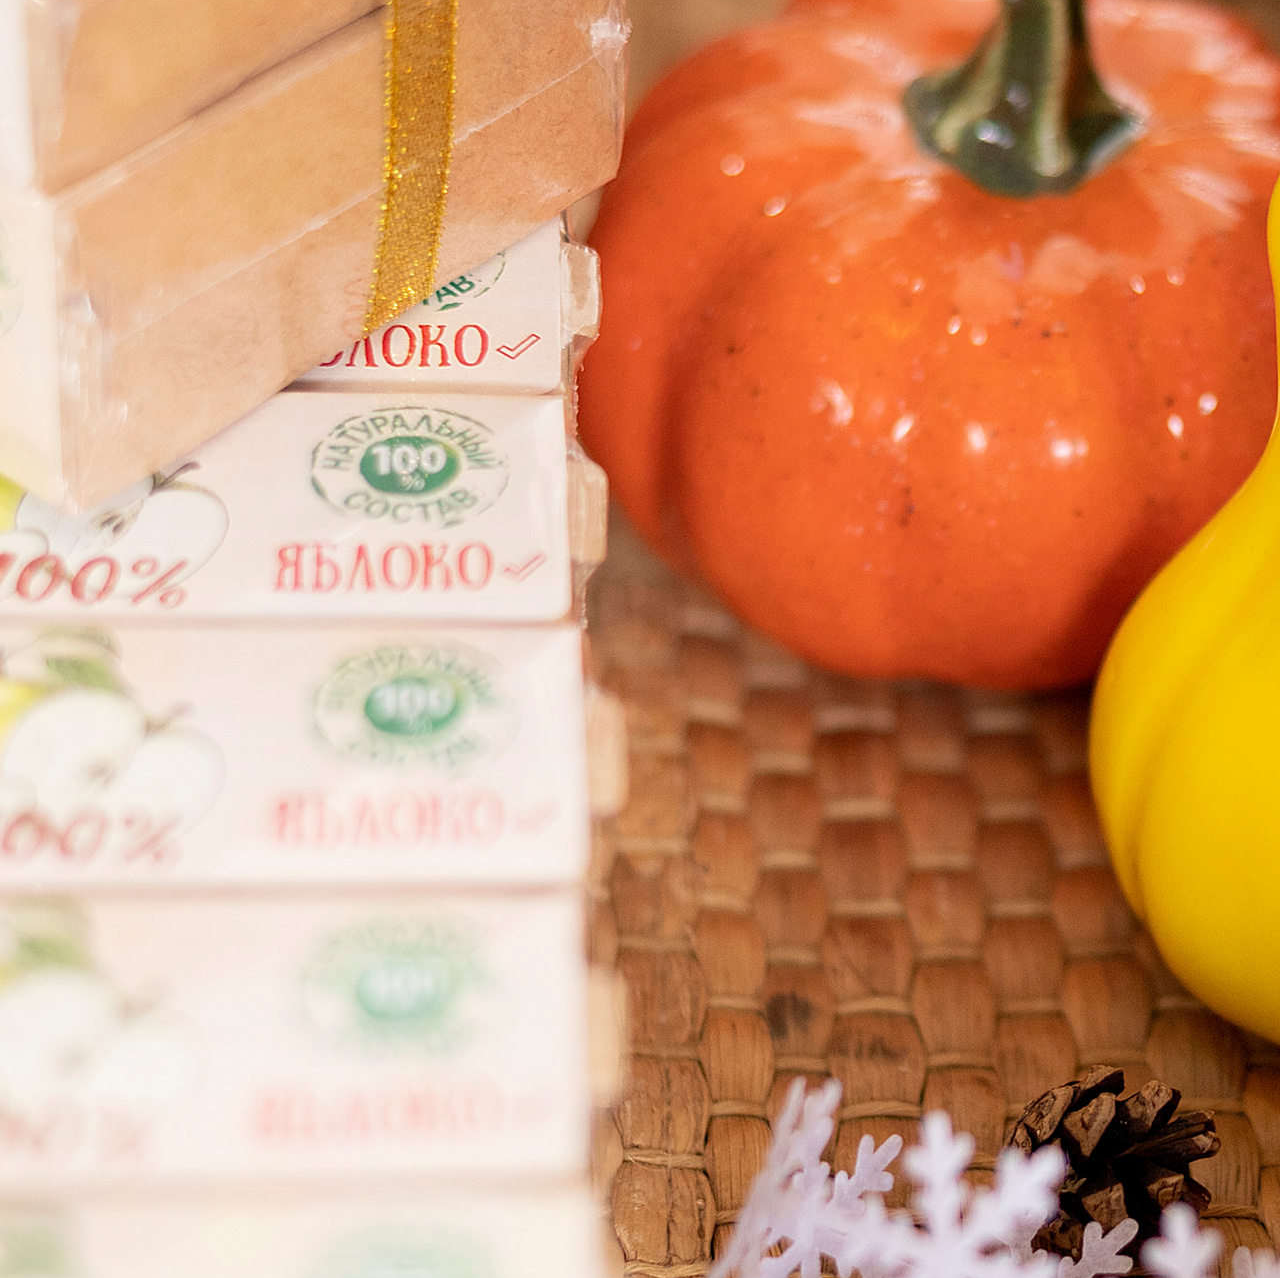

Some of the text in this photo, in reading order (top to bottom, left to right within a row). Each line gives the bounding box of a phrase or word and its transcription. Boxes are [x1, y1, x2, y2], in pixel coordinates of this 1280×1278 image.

[371, 443, 448, 476] 100
[343, 488, 479, 523] СОСТАВ
[273, 540, 496, 593] ЯБЛОКО
[0, 806, 184, 867] 00%
